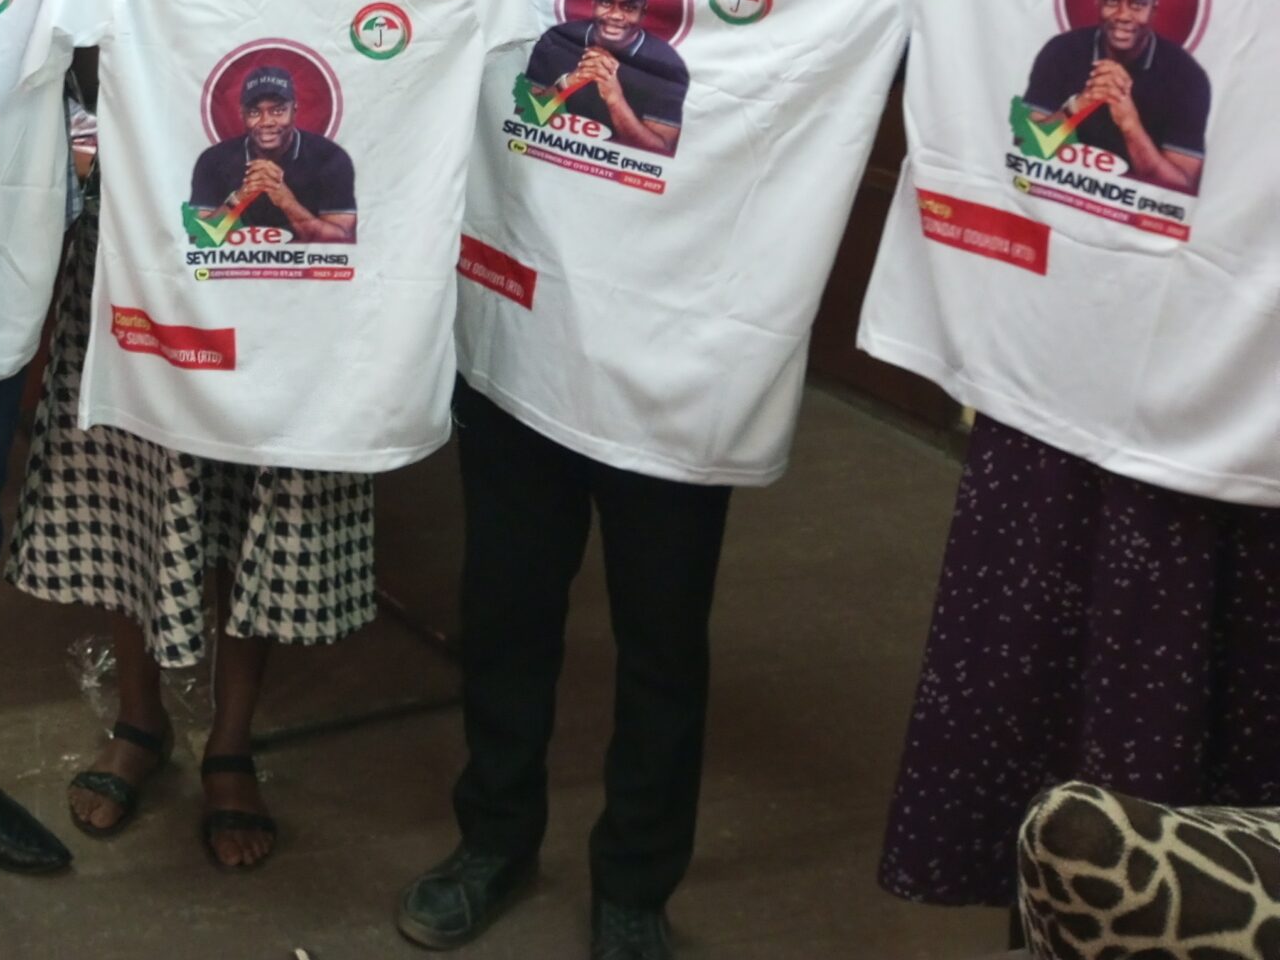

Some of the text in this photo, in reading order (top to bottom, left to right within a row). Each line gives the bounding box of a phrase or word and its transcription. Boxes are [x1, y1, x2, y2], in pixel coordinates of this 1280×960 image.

[503, 119, 663, 178] SEYI MAKINDE (FNSE)
[1005, 152, 1041, 177] SEYI
[1043, 164, 1136, 206] MAKINDE
[186, 250, 349, 266] SEYI MAKINDE (FNSE)
